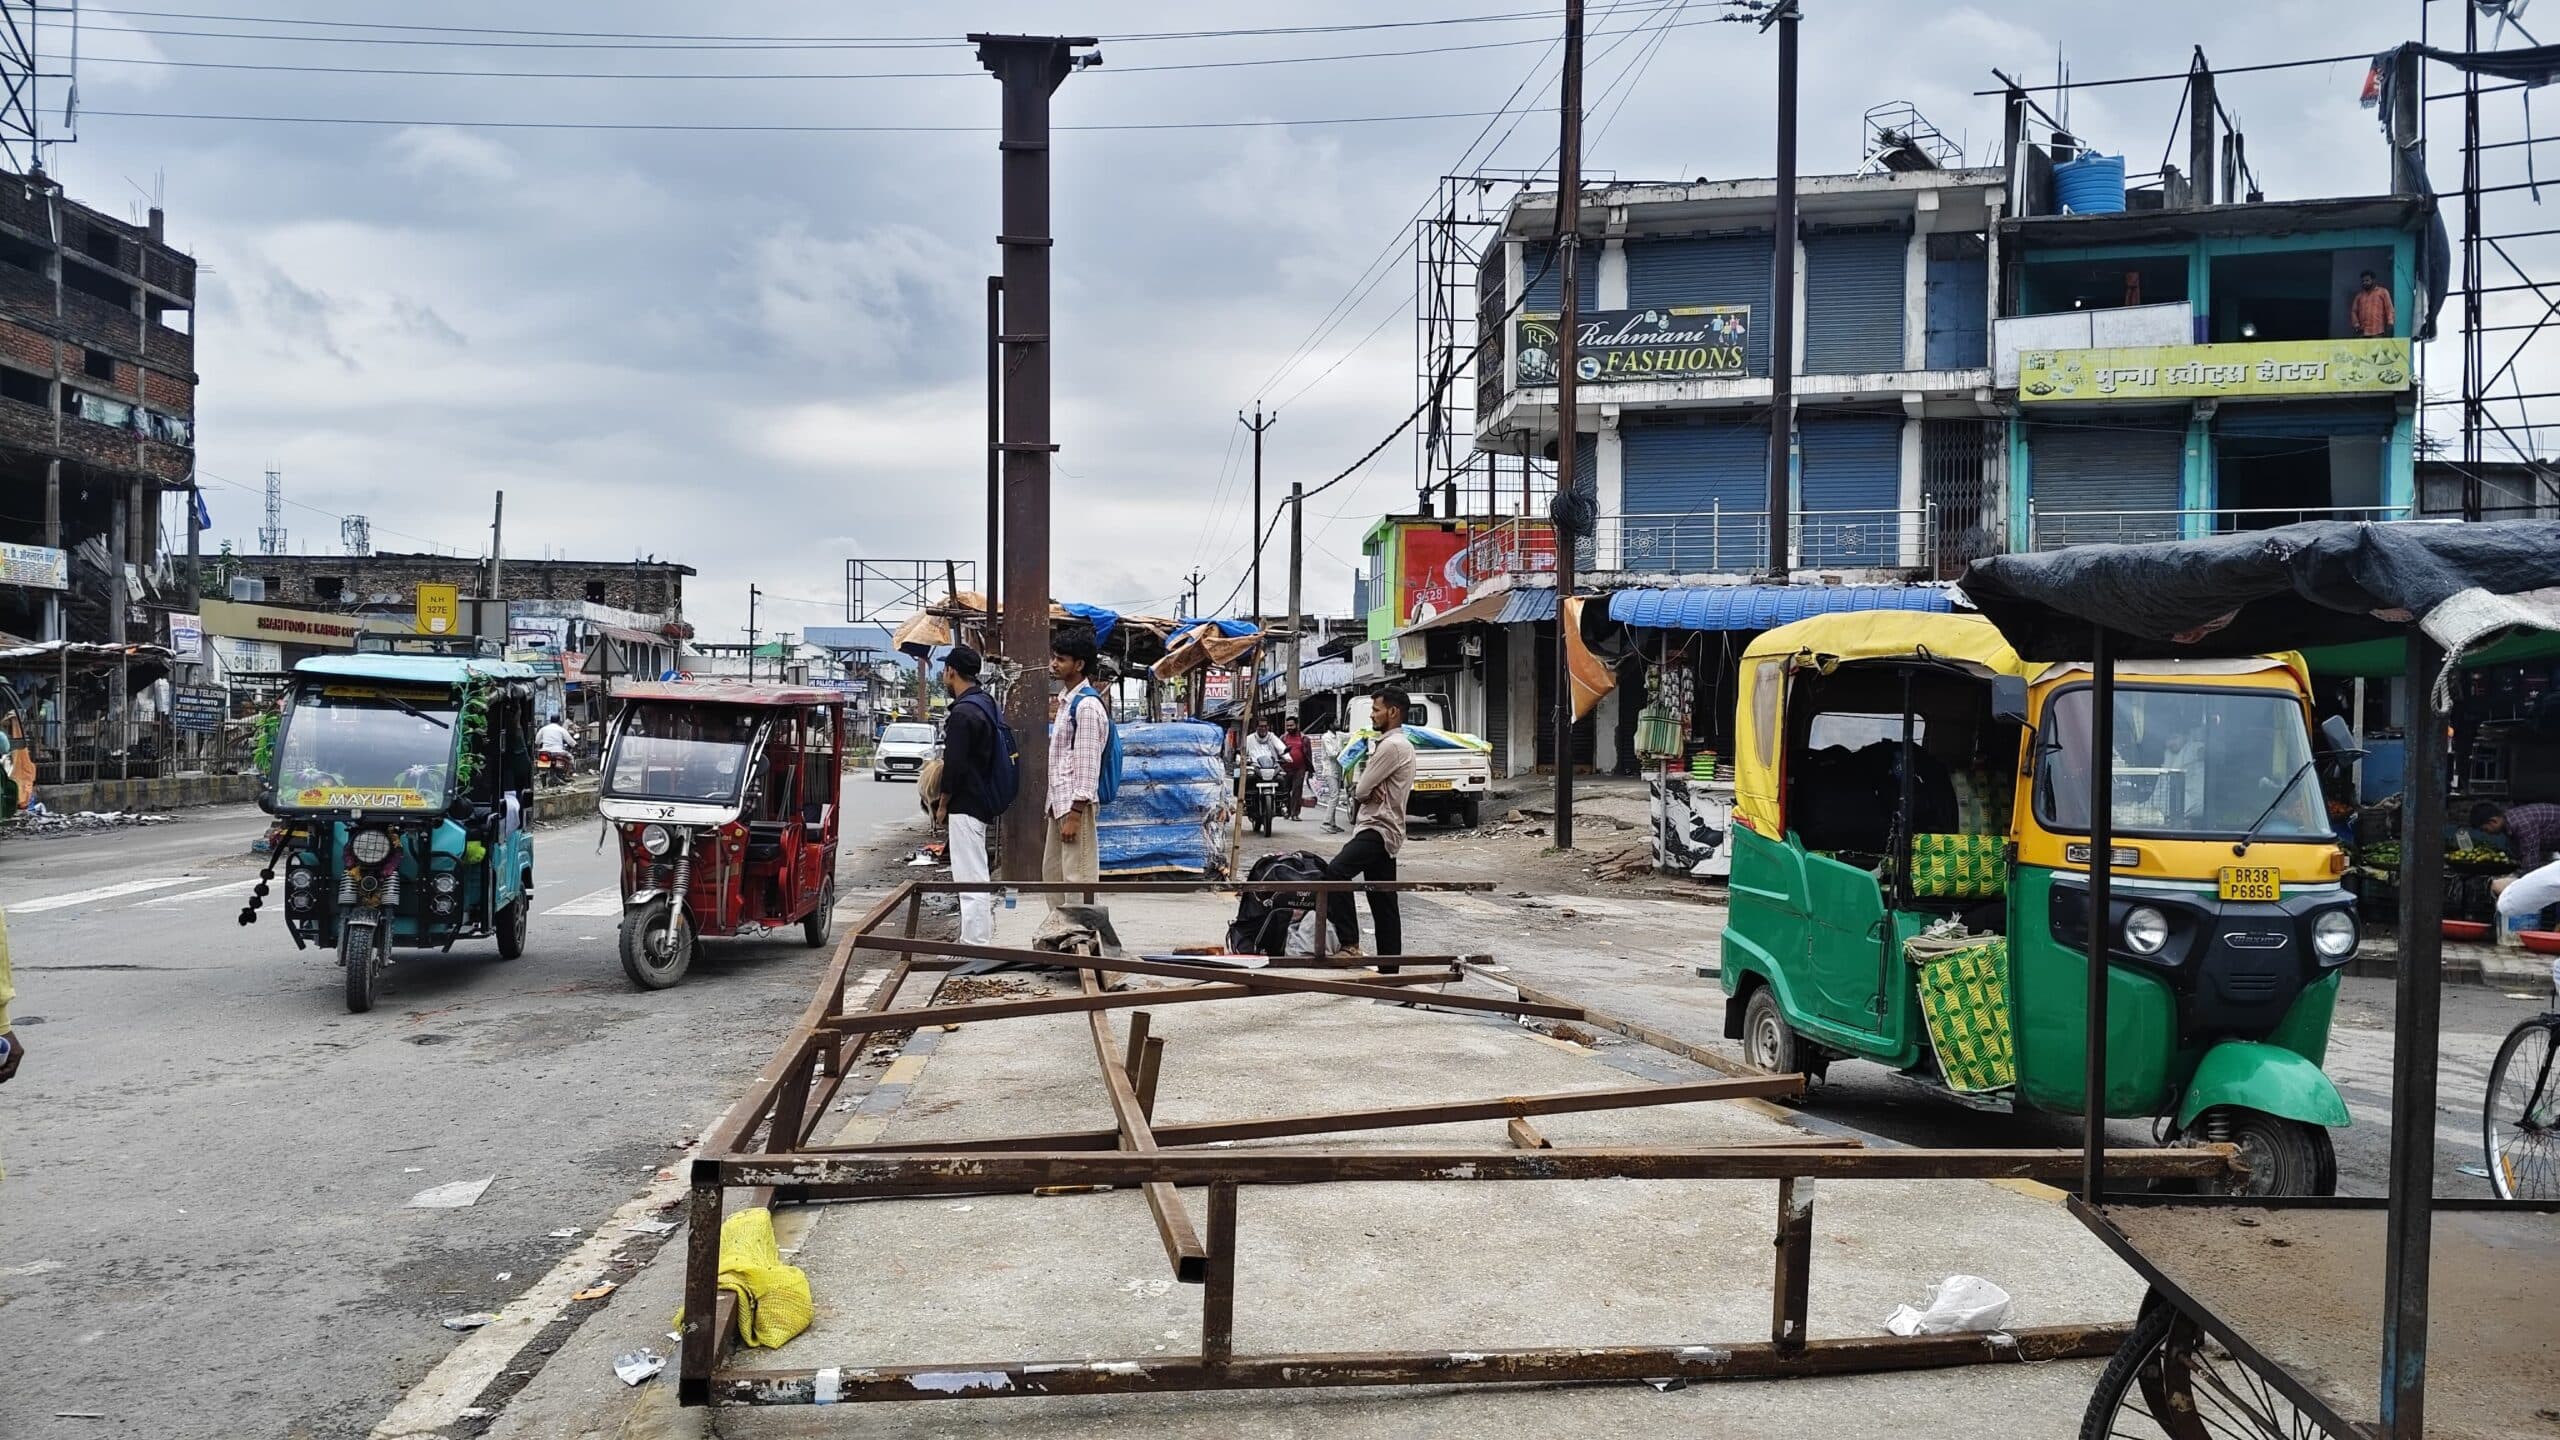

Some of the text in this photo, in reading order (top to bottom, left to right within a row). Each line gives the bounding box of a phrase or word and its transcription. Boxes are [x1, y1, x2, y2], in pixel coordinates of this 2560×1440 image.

[1577, 314, 1709, 346] Rahmani
[1528, 330, 1547, 348] RF
[1604, 346, 1743, 373] FASHIONS
[2095, 359, 2329, 393] मुन्ना स्वीट्स होटल
[426, 605, 448, 614] 327E
[284, 618, 306, 633] FOOD
[328, 793, 402, 807] MAYURI
[2236, 869, 2268, 883] BR38
[2231, 884, 2272, 898] P6856
